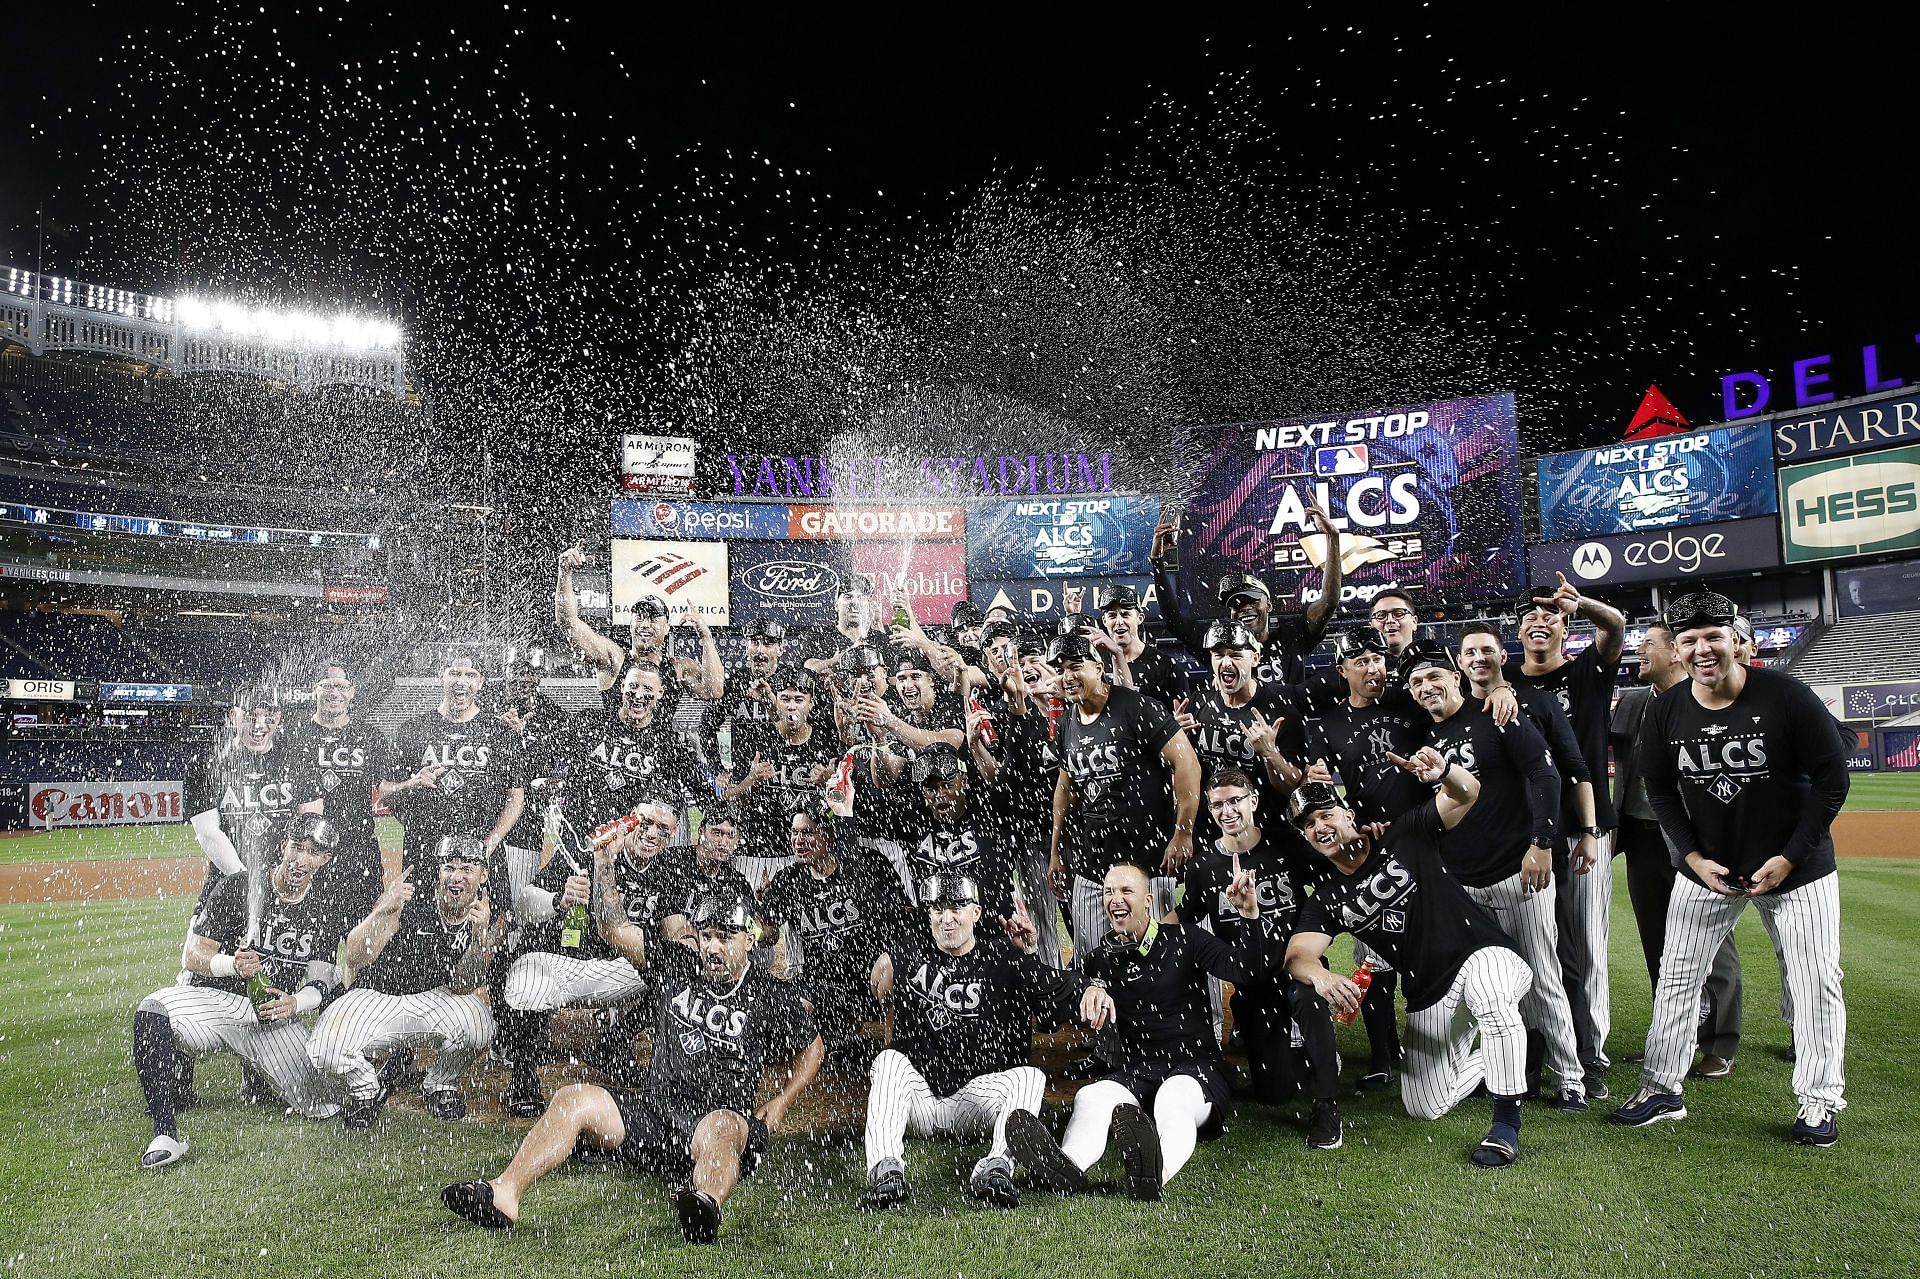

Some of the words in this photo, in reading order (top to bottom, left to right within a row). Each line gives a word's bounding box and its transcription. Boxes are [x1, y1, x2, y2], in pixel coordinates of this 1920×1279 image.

[1722, 334, 1920, 420] DEL
[1255, 422, 1336, 450] NEXT
[1344, 411, 1428, 441] STOP
[1595, 445, 1649, 465] NEXT
[1654, 435, 1709, 457] STOP
[1617, 468, 1689, 498] ALCS
[1016, 503, 1057, 516] NEXT
[1065, 501, 1110, 514] STOP
[1268, 473, 1421, 534] ALCS
[1796, 482, 1918, 528] HESS
[684, 511, 752, 532] pepsi
[800, 512, 953, 533] GATORADE
[1034, 527, 1093, 547] ALCS
[1274, 549, 1307, 562] 20
[1387, 539, 1422, 554] 22
[1624, 532, 1726, 573] edge
[49, 572, 70, 581] CLUB
[762, 563, 822, 593] Ford
[24, 682, 64, 693] ORIS
[1198, 728, 1255, 759] ALCS
[1347, 716, 1410, 745] YANKEES
[421, 744, 491, 766] ALCS
[589, 742, 655, 775] ALCS
[1068, 746, 1118, 775] ALCS
[1678, 739, 1767, 772] ALCS
[32, 788, 181, 823] Canon
[220, 782, 294, 809] ALCS
[917, 831, 978, 863] ALCS
[1219, 876, 1294, 915] ACS
[1342, 860, 1411, 928] ALCS
[800, 899, 860, 933] ALCS
[911, 964, 982, 1009] ALCS
[672, 987, 748, 1037] ALCS
